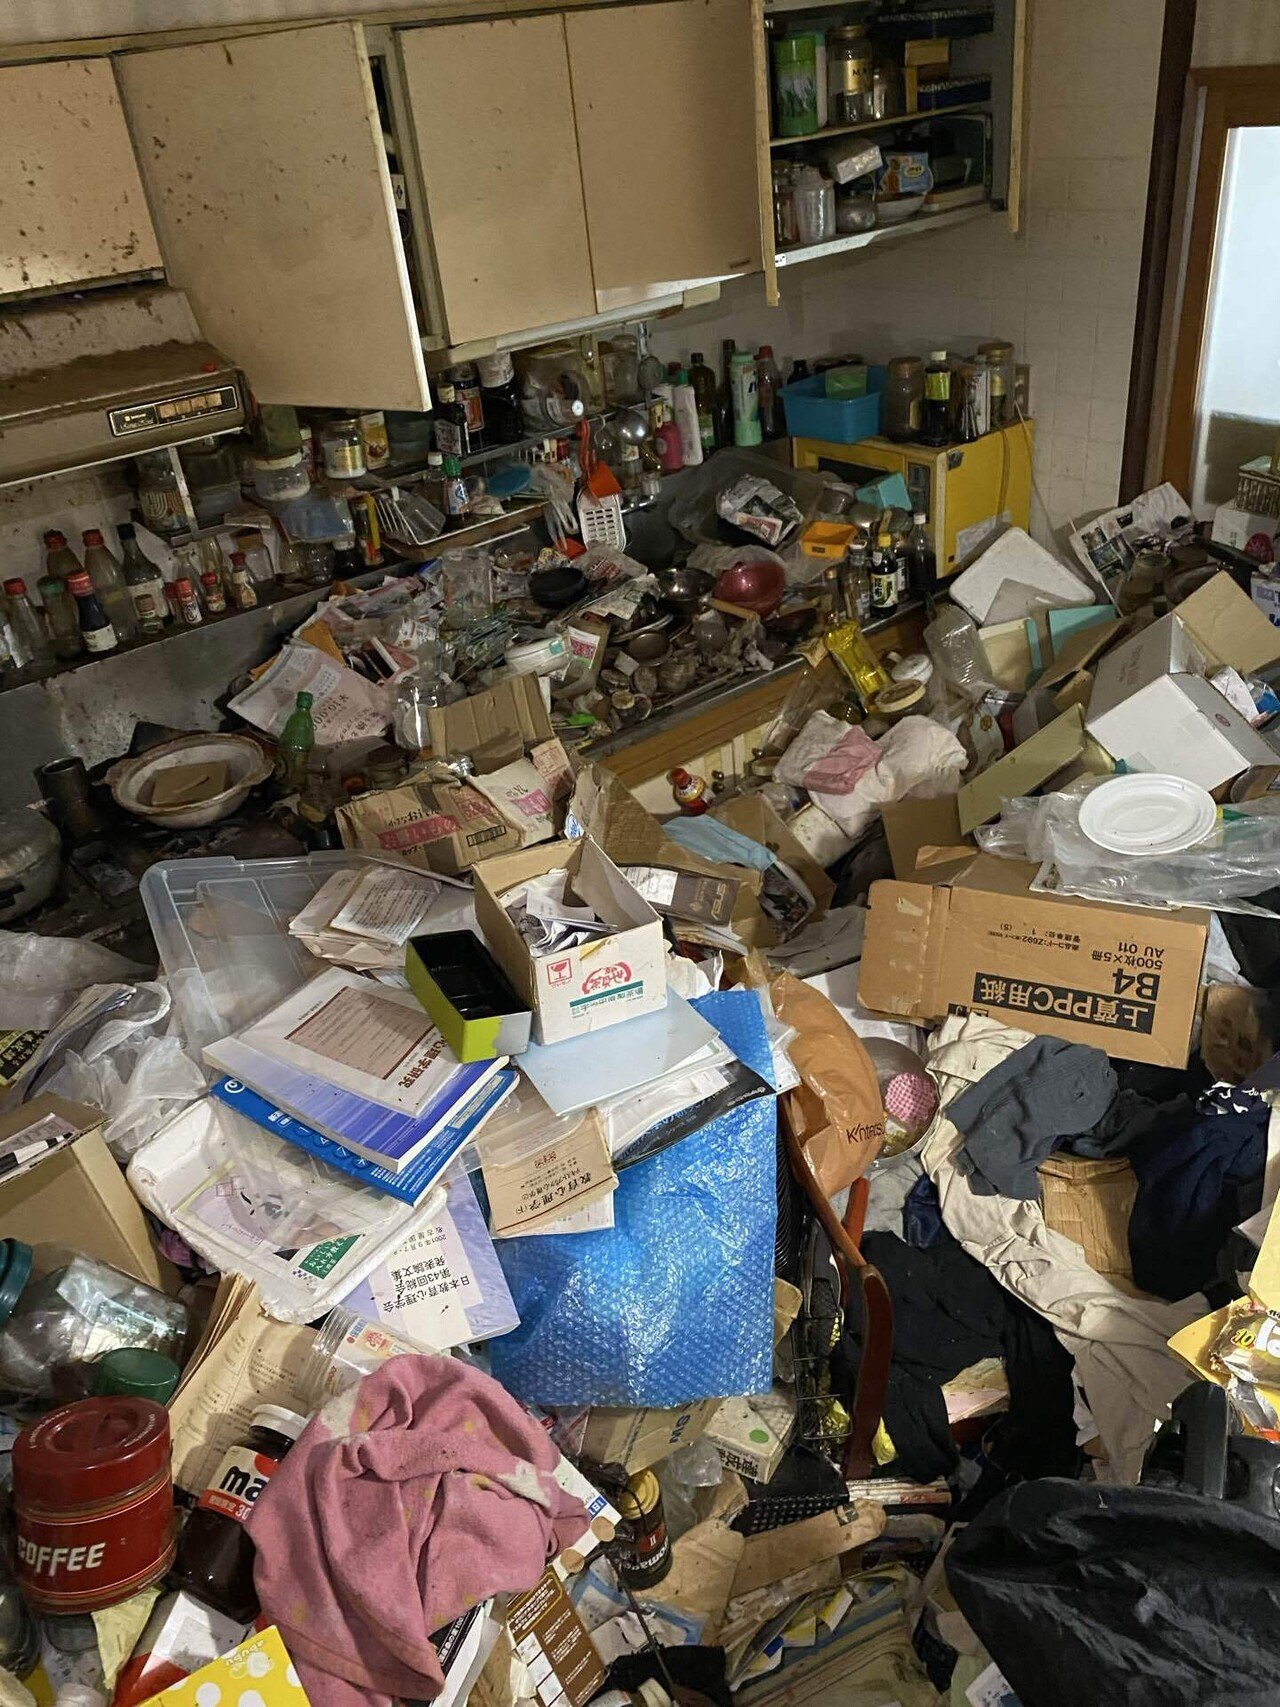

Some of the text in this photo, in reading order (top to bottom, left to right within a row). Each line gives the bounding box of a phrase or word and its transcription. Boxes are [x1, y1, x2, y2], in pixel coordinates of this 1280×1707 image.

[1118, 941, 1164, 959] AU 011
[1112, 967, 1161, 1001] B4
[980, 977, 1149, 1028] 上質PPC用紙
[391, 1255, 446, 1283] 発表論文集
[394, 1266, 452, 1295] 第43回総会
[382, 1274, 471, 1314] 日本教育心理学会
[1231, 1328, 1256, 1350] 10
[17, 1534, 106, 1578] COFFEE
